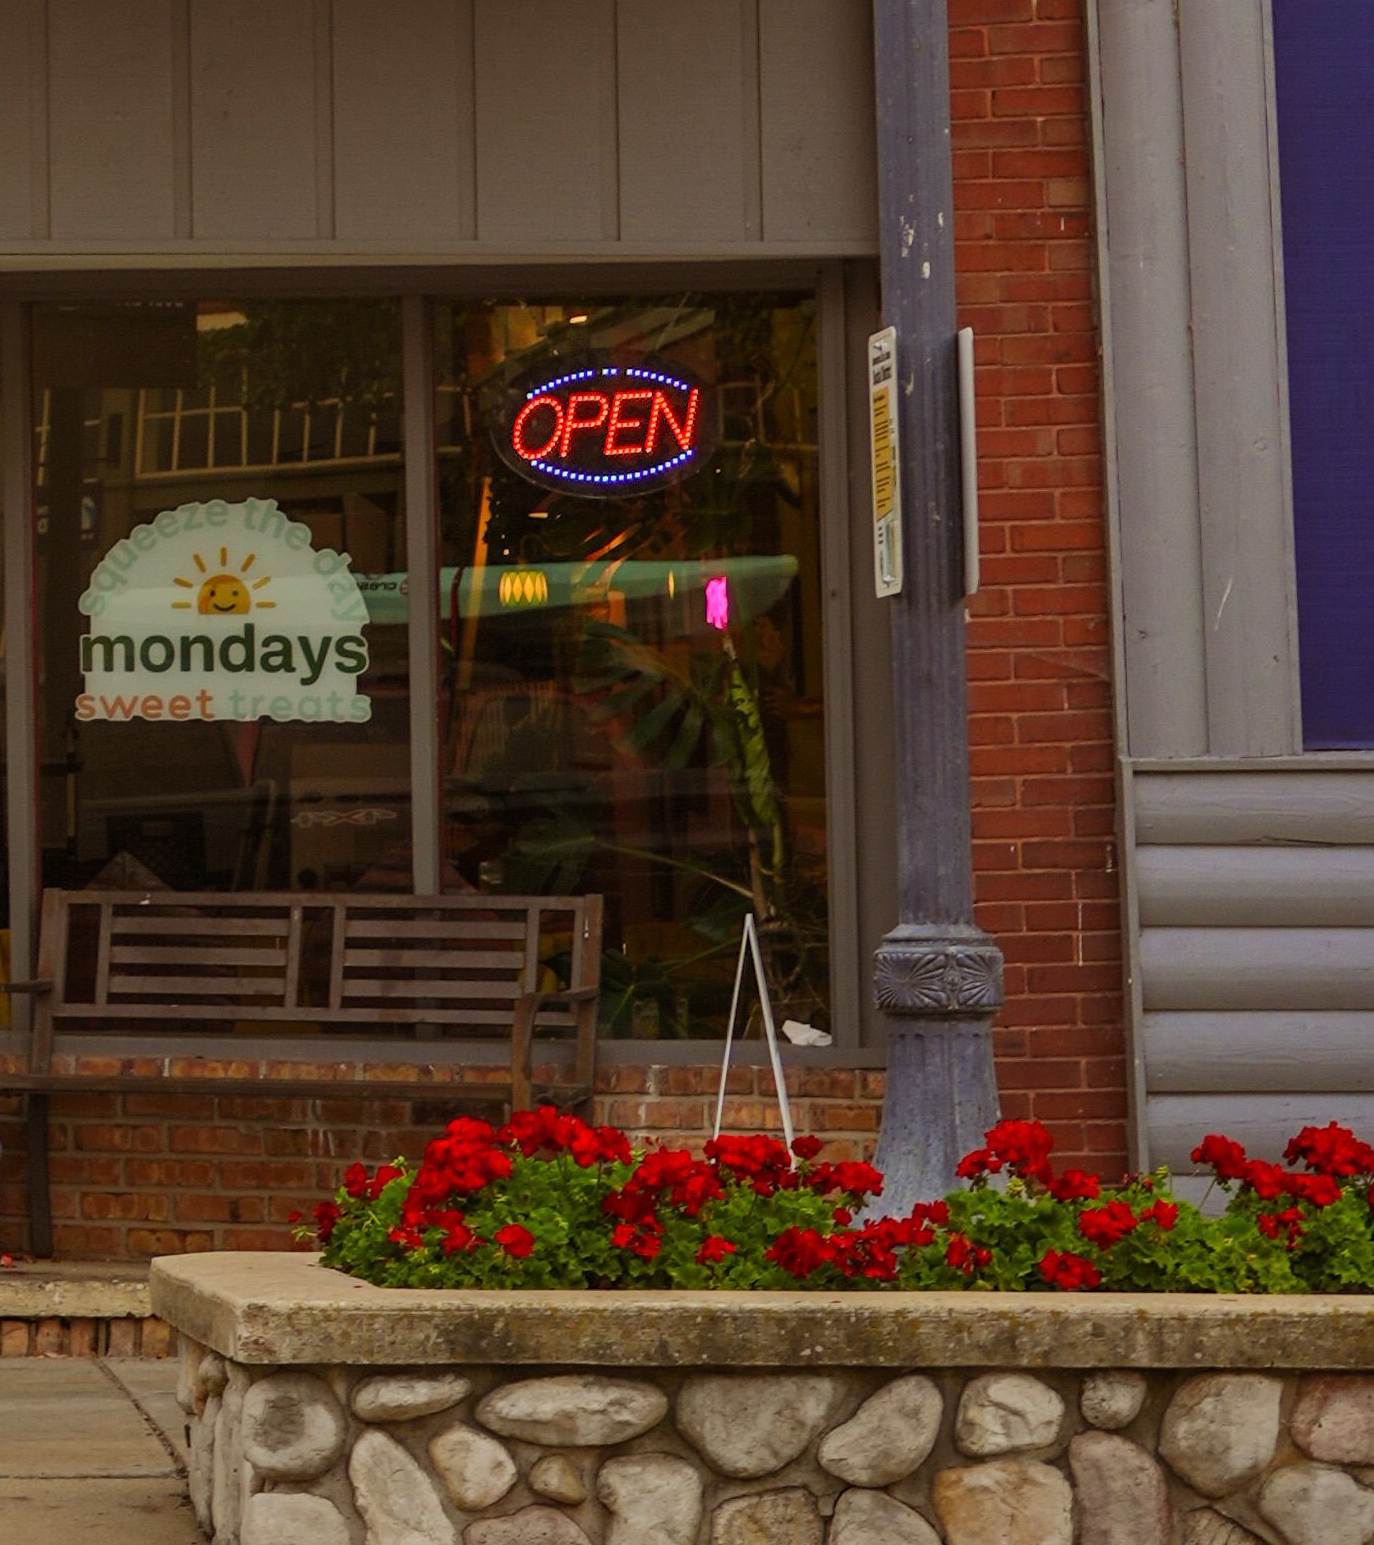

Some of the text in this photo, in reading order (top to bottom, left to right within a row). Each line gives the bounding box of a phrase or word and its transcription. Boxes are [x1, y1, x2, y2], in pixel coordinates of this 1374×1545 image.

[512, 387, 699, 460] OPEN
[80, 497, 368, 621] squeeze the day
[82, 623, 368, 685] mondays
[76, 689, 371, 719] sweet treats
